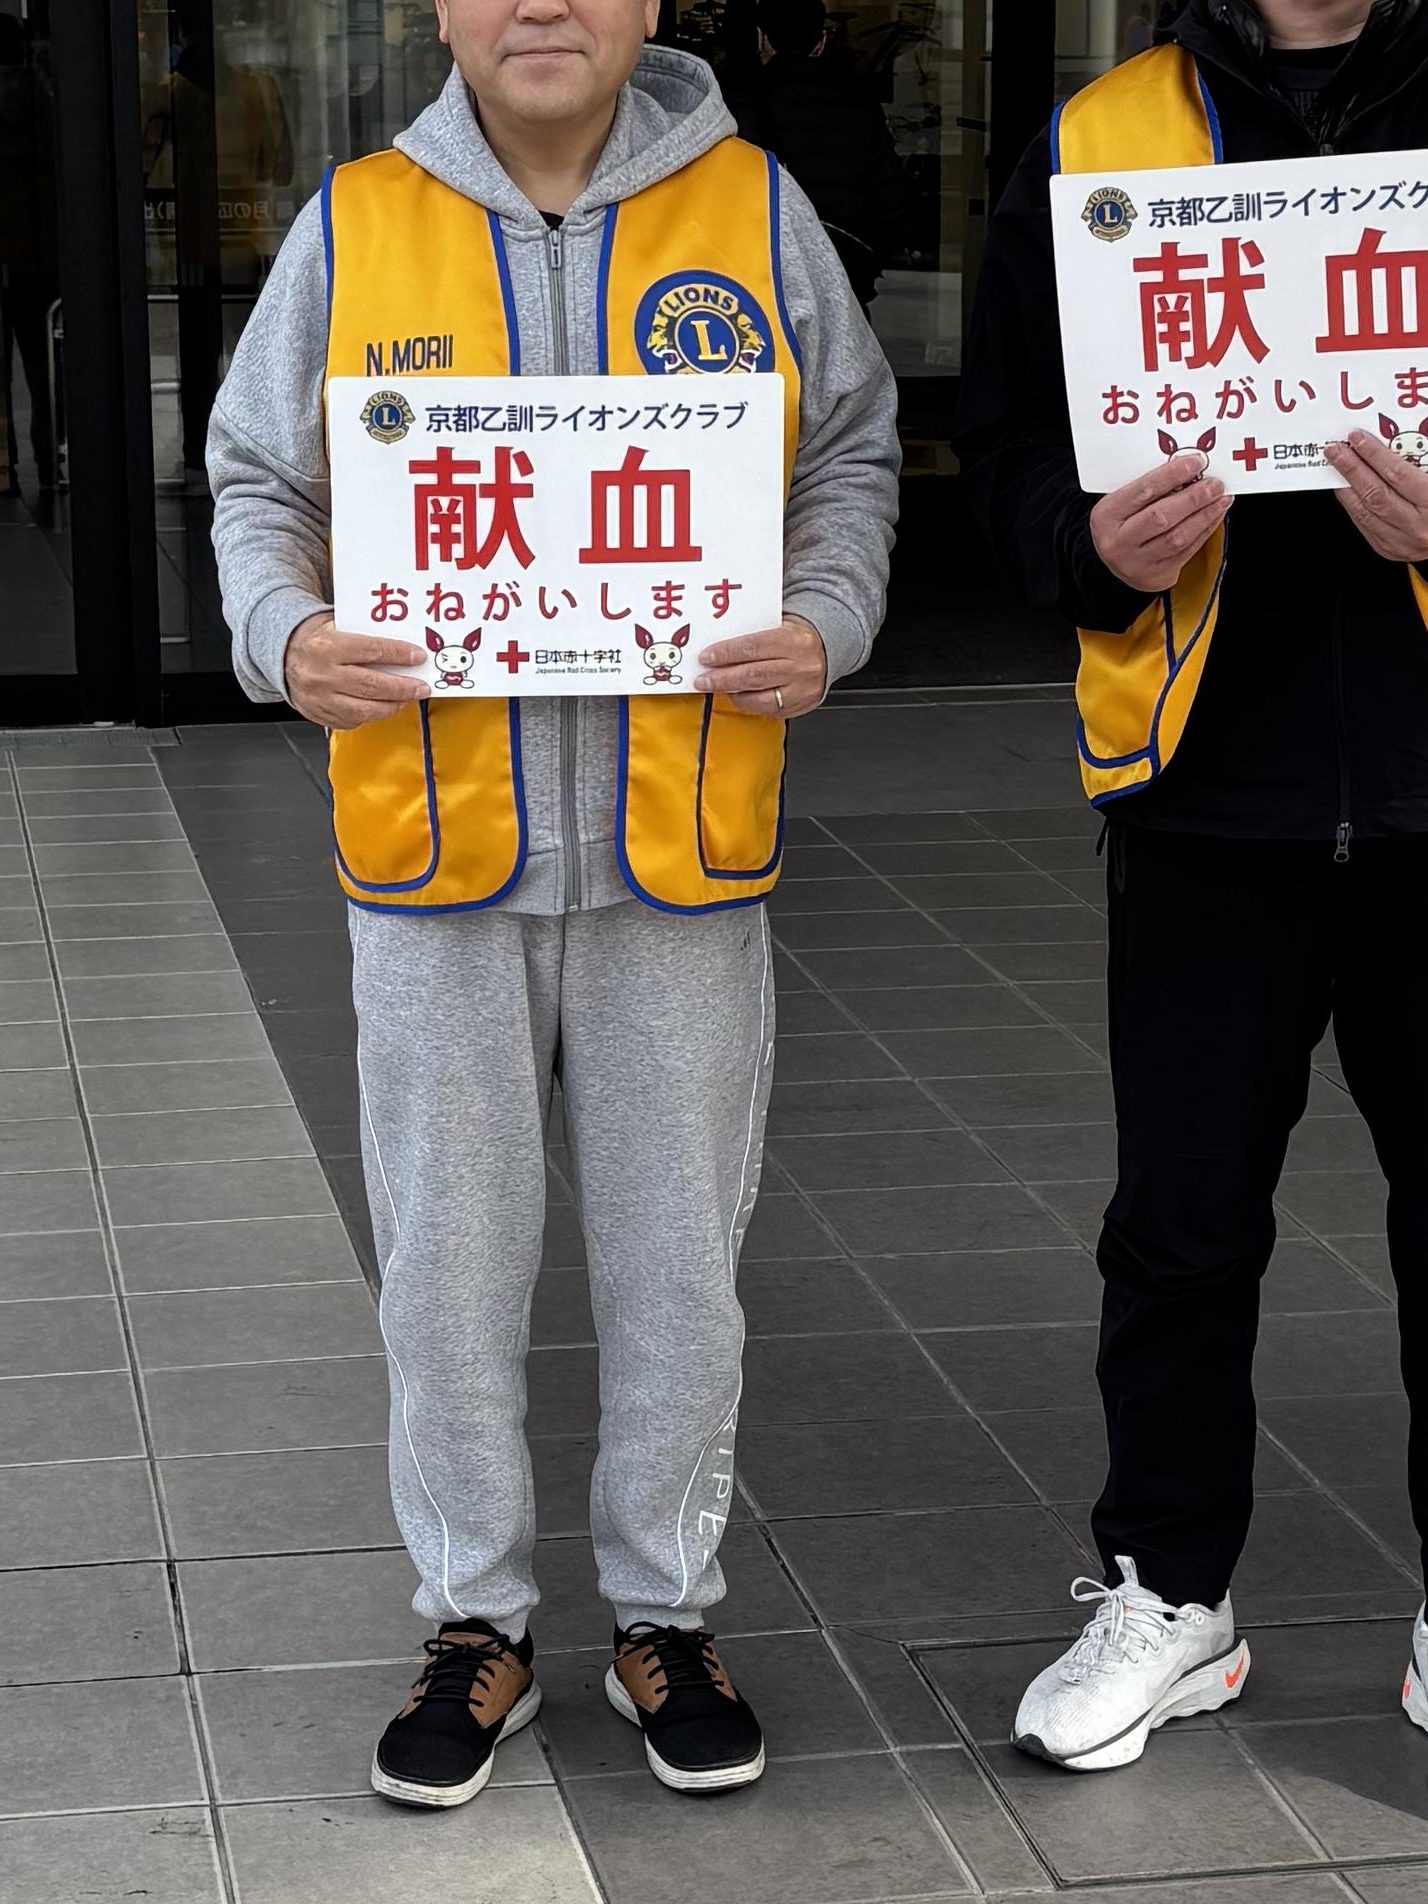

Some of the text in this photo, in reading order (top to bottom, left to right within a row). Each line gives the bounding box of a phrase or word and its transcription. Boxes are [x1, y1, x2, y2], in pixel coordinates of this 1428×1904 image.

[663, 286, 735, 313] LIONS
[365, 334, 454, 377] N.MORII
[690, 319, 728, 361] L
[424, 400, 749, 433] 京都乙訓ライオンズクラブ
[408, 444, 703, 572] 献血
[369, 578, 743, 624] おねがいします
